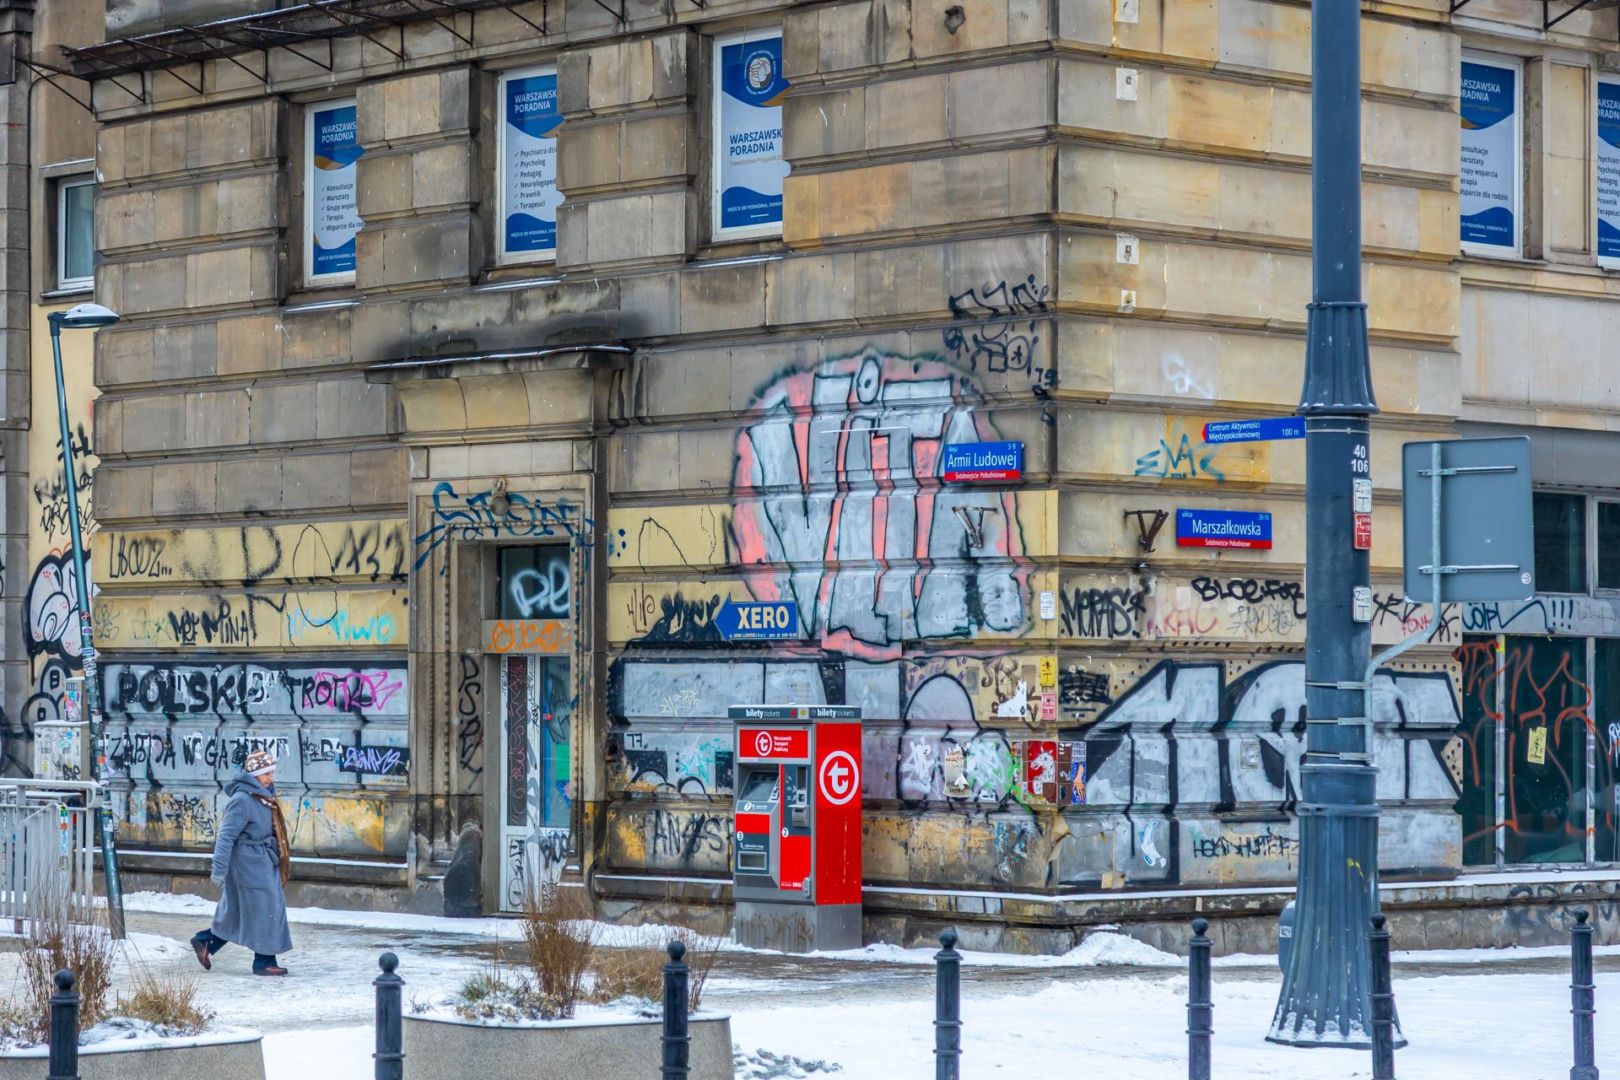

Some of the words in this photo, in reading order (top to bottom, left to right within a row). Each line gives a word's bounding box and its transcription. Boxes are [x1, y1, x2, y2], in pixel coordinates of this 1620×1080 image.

[513, 100, 551, 114] PORADNIA
[321, 131, 354, 144] PORADNIA
[520, 148, 547, 158] Psychiatra
[729, 141, 775, 157] PORADNIA
[520, 159, 546, 168] Psycholog
[520, 170, 542, 179] Pedagog
[326, 183, 353, 192] Konsultacje
[326, 193, 349, 202] Warsztaty
[520, 190, 541, 198] Prawnik
[1482, 190, 1491, 198] dla
[520, 200, 545, 209] Terapeuci
[326, 223, 347, 232] Wsparcie
[1208, 423, 1230, 432] Centrum
[1231, 421, 1260, 431] Aktywności
[1281, 428, 1293, 437] 100
[1353, 444, 1366, 459] 40
[947, 452, 971, 468] Armii
[973, 450, 1017, 470] Ludowej
[1351, 459, 1369, 473] 106
[1192, 519, 1262, 536] Marszałkowska
[737, 605, 790, 630] XERO
[745, 708, 764, 719] bilety
[817, 708, 837, 719] bilety
